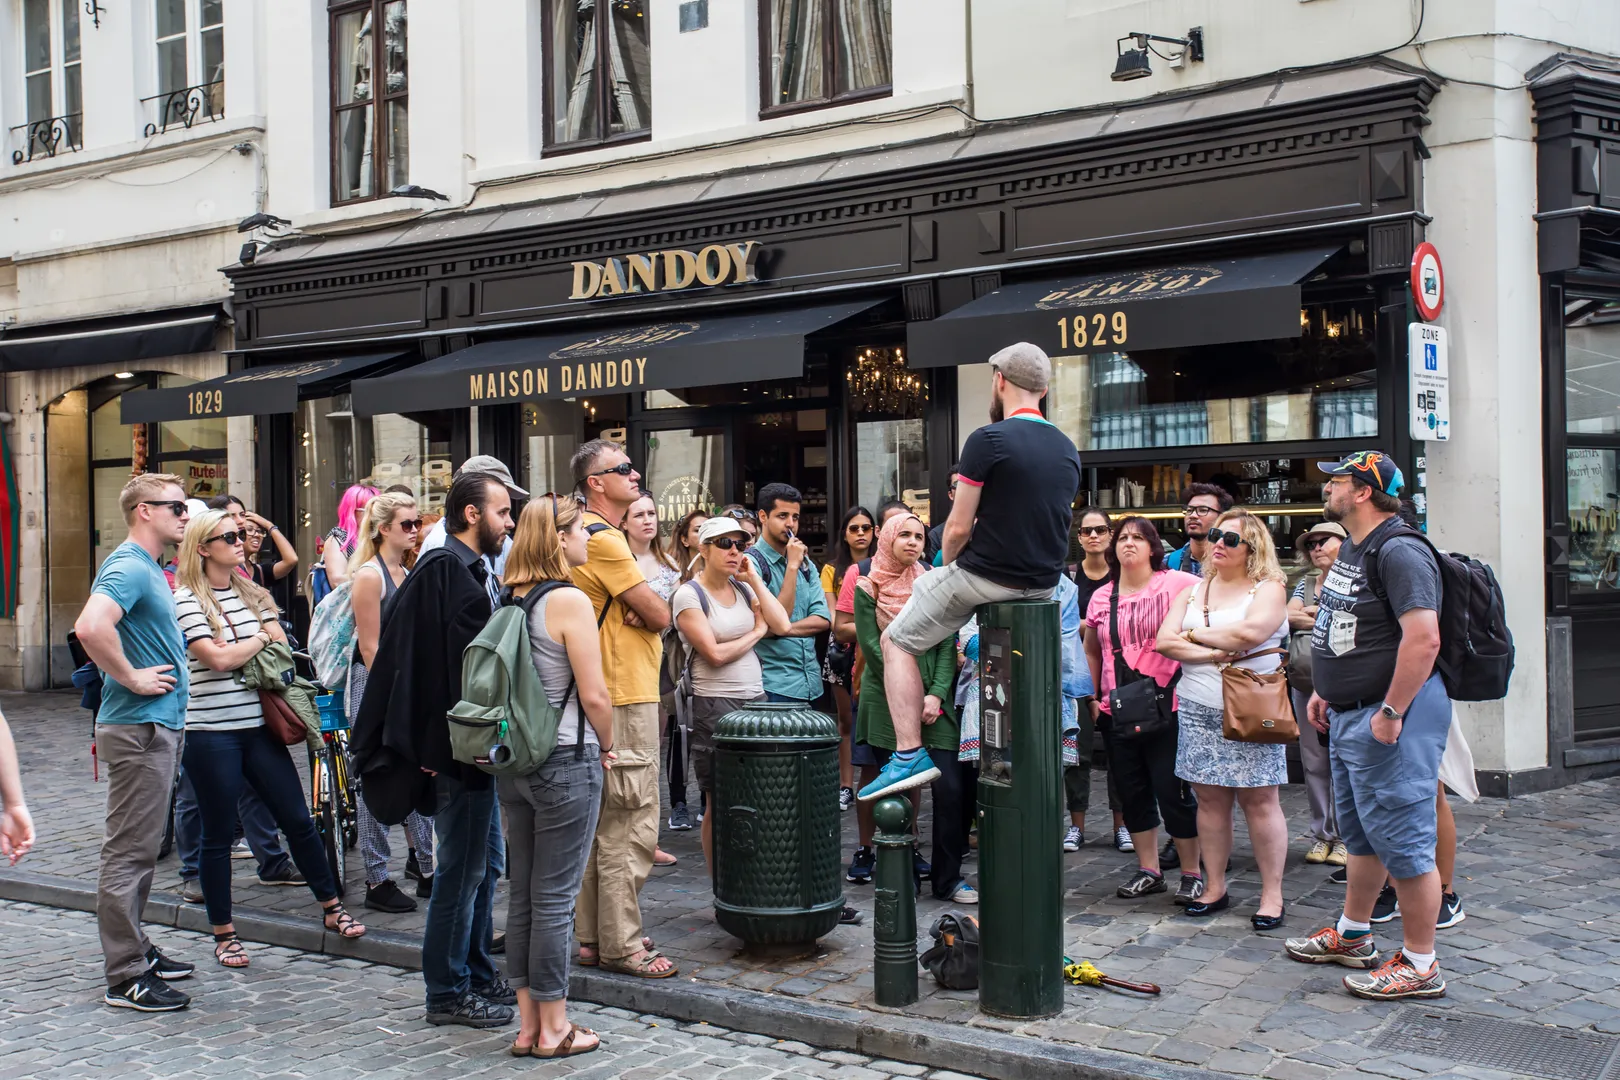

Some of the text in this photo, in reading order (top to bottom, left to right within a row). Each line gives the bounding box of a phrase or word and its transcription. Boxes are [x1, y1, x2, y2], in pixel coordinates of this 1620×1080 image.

[568, 240, 763, 300] DANDOY
[1039, 274, 1223, 302] DANDOY
[1057, 311, 1128, 349] 1829
[1421, 328, 1439, 341] ZONE
[470, 357, 648, 400] MAISON DANDOY
[188, 389, 223, 415] 1829
[668, 494, 704, 503] MAISON
